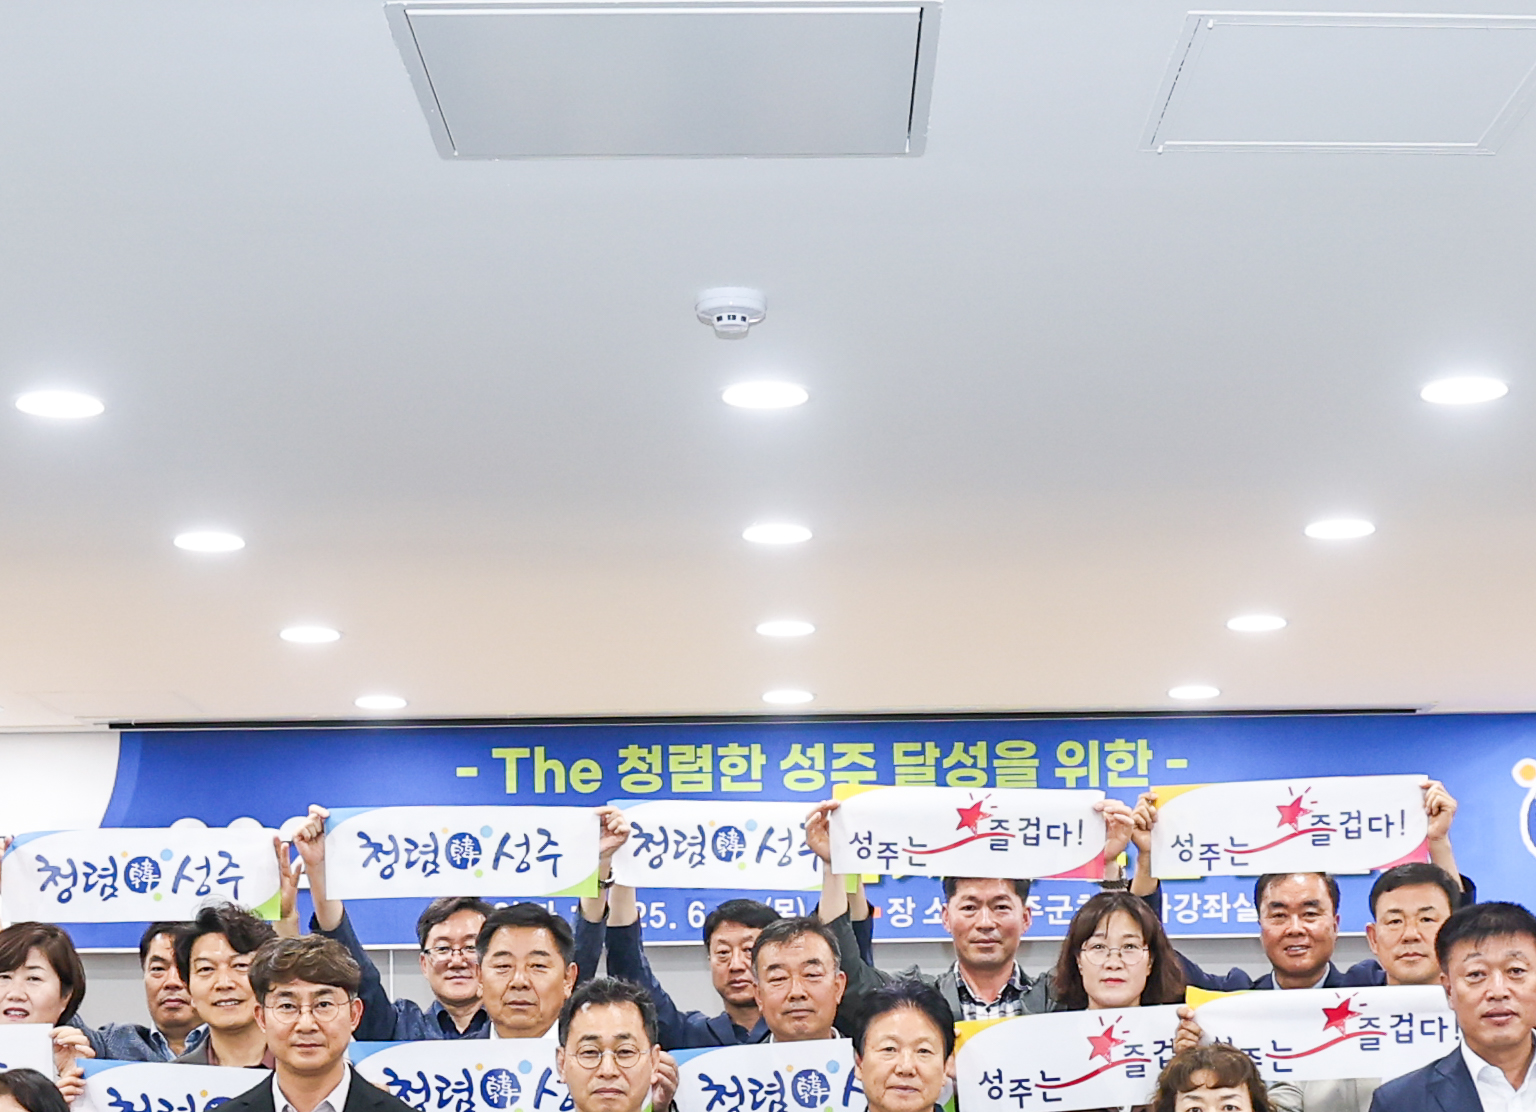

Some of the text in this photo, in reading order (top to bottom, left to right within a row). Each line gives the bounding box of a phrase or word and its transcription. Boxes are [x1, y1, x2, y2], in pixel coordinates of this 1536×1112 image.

[491, 746, 603, 794] The
[617, 743, 767, 793] 청렴한
[780, 742, 877, 792] 성주
[892, 740, 1040, 788] 달성을
[1054, 739, 1154, 788] 위한
[492, 827, 563, 878] 성주
[849, 817, 1084, 870] 성주는 즐겁다!
[1171, 809, 1406, 871] 성주는 즐겁다!
[172, 850, 245, 900] 성주
[1358, 1012, 1462, 1052] 즐겁다!
[978, 1067, 1063, 1109] 성주는
